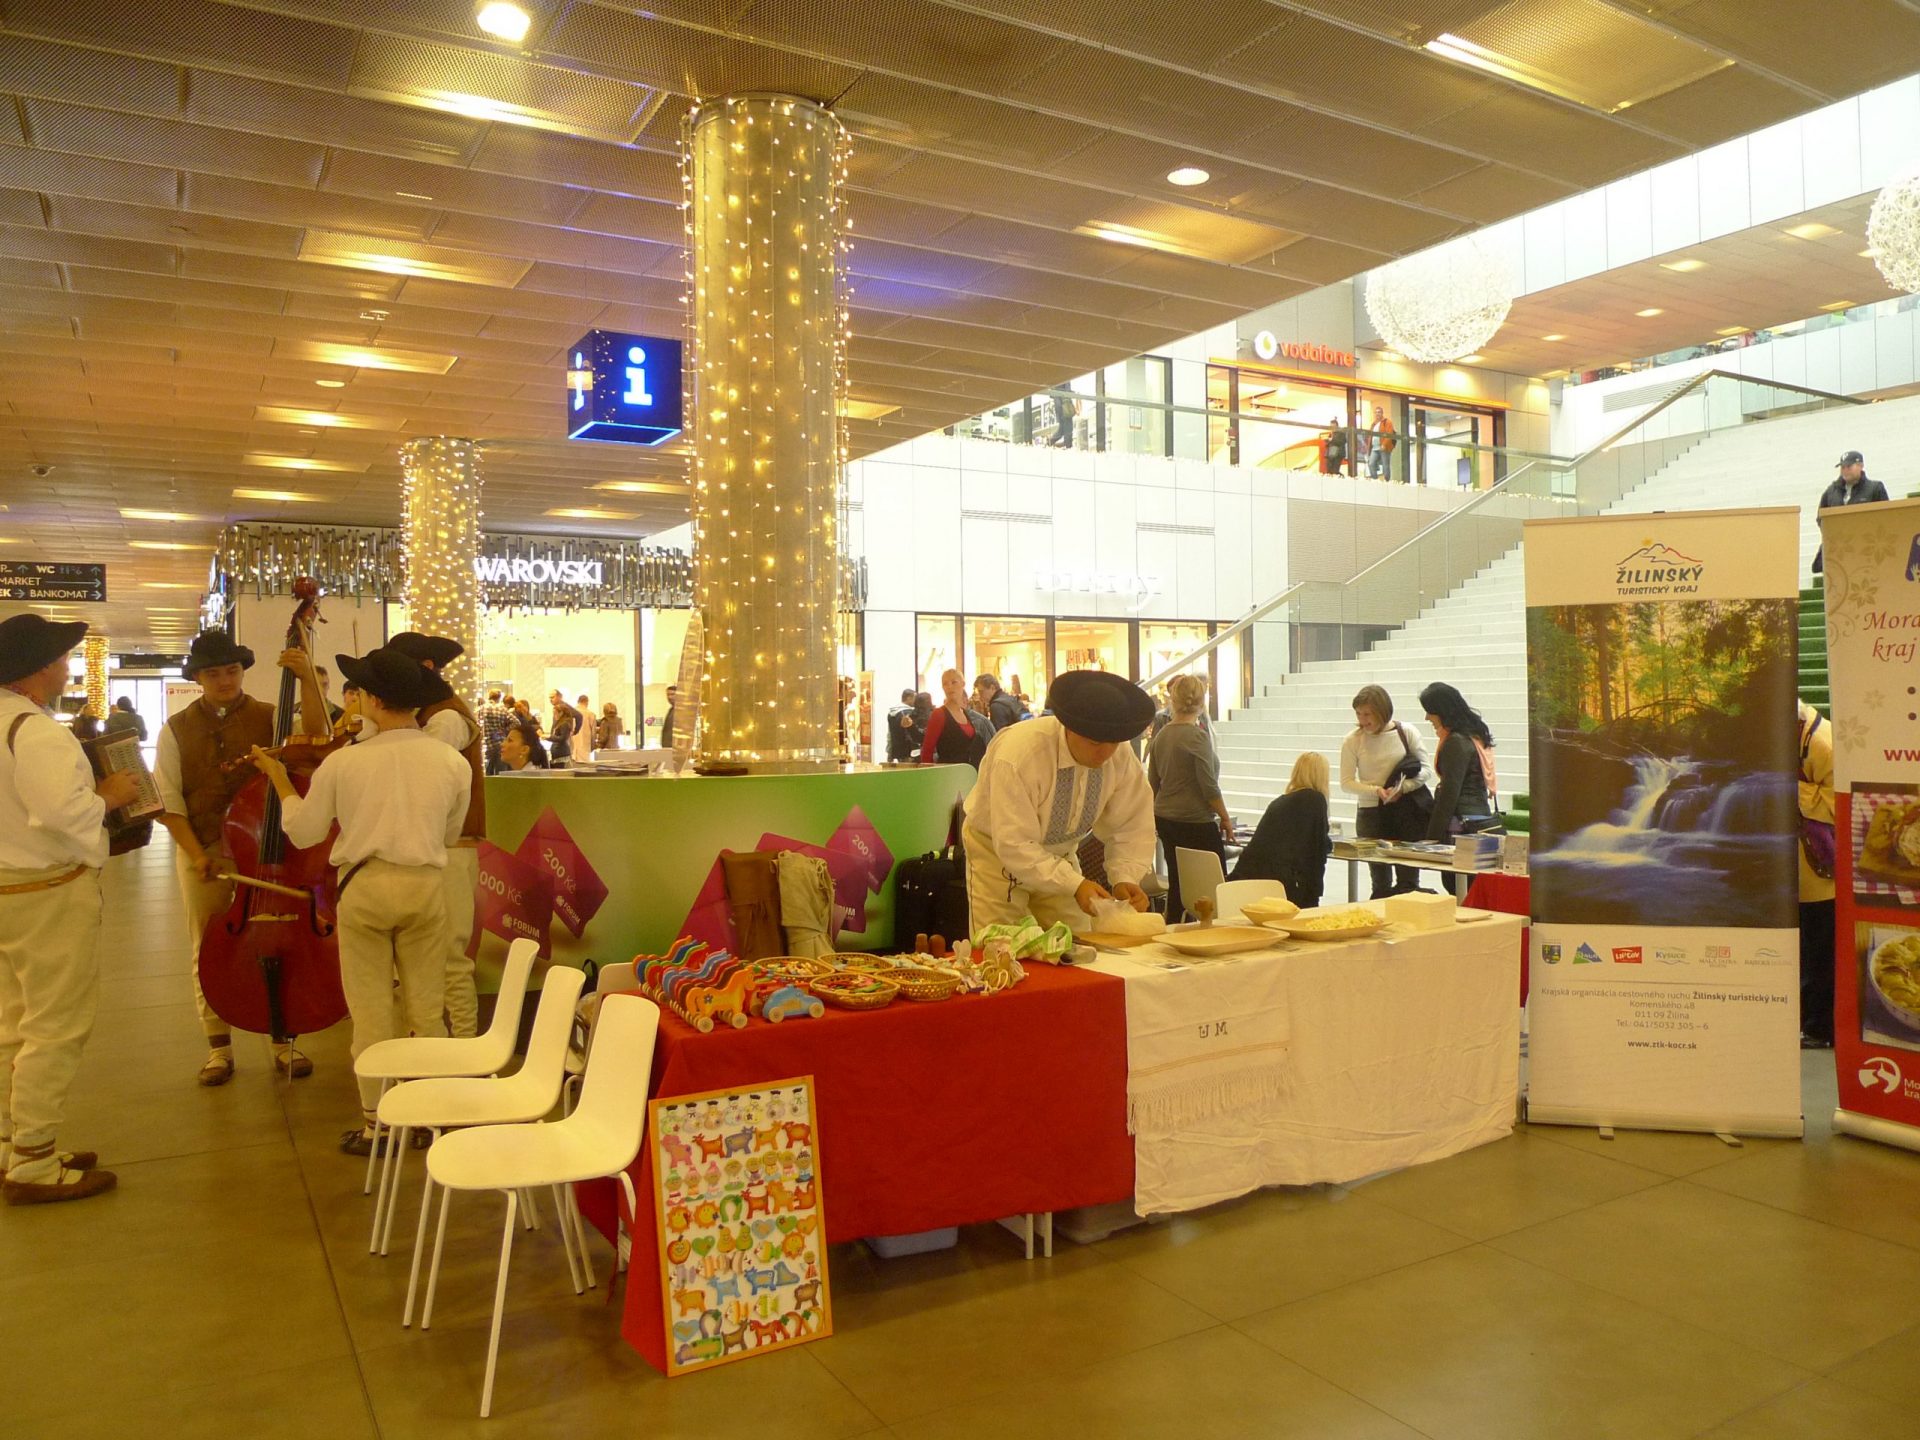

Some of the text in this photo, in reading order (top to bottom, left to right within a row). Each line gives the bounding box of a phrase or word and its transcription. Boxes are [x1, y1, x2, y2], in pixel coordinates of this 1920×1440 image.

[1280, 341, 1354, 367] vodafone
[36, 565, 55, 574] WC
[1616, 564, 1703, 584] ŽILINSKÝ
[30, 589, 88, 599] BANKOMAT
[1617, 584, 1698, 596] TURISTICKÝ KRAJ
[1872, 636, 1918, 663] kraj
[852, 834, 869, 855] 200
[543, 847, 566, 878] 200
[507, 885, 522, 905] Kč
[563, 902, 581, 925] FORUM
[513, 918, 540, 938] FORUM
[1655, 952, 1686, 961] Kysuce
[1541, 987, 1788, 1004] Krajská organizácia cestovného ruchu Žilinský turistický kraj
[1630, 1000, 1695, 1010] Komenského 48
[1635, 1010, 1690, 1019] 011 09 Žilina
[1677, 1021, 1694, 1030] 305
[1627, 1039, 1697, 1050] www.ztk-kocr.sk
